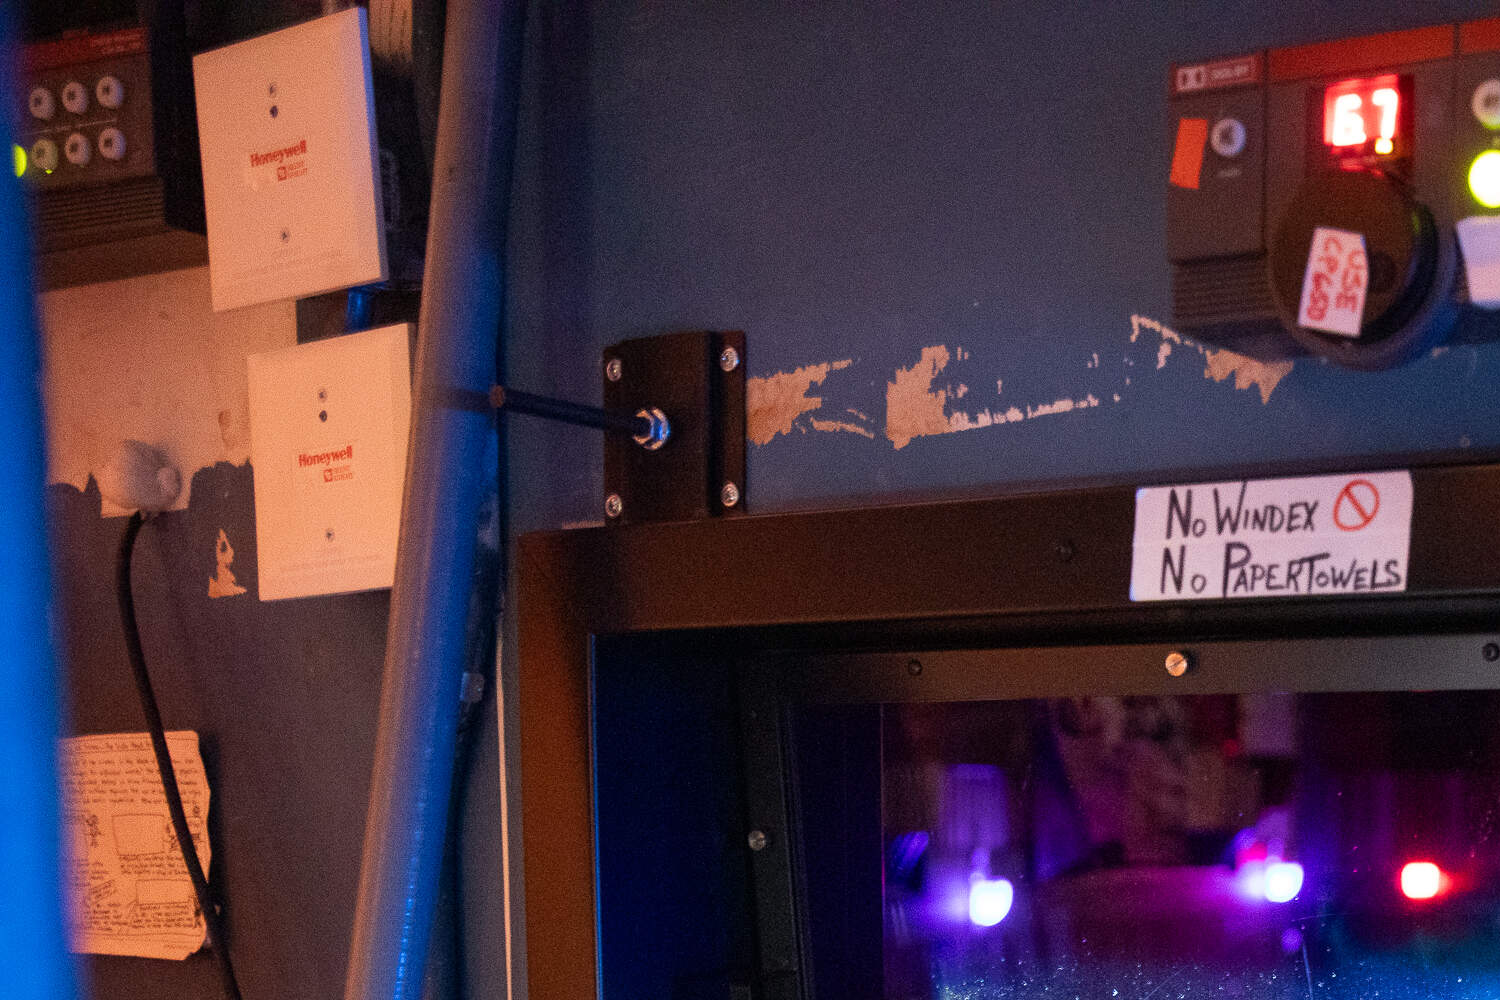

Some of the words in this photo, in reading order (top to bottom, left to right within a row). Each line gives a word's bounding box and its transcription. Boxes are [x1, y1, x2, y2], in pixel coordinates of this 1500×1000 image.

[249, 139, 307, 168] Honeywell
[1335, 249, 1367, 314] USE
[298, 445, 353, 467] Honeywell
